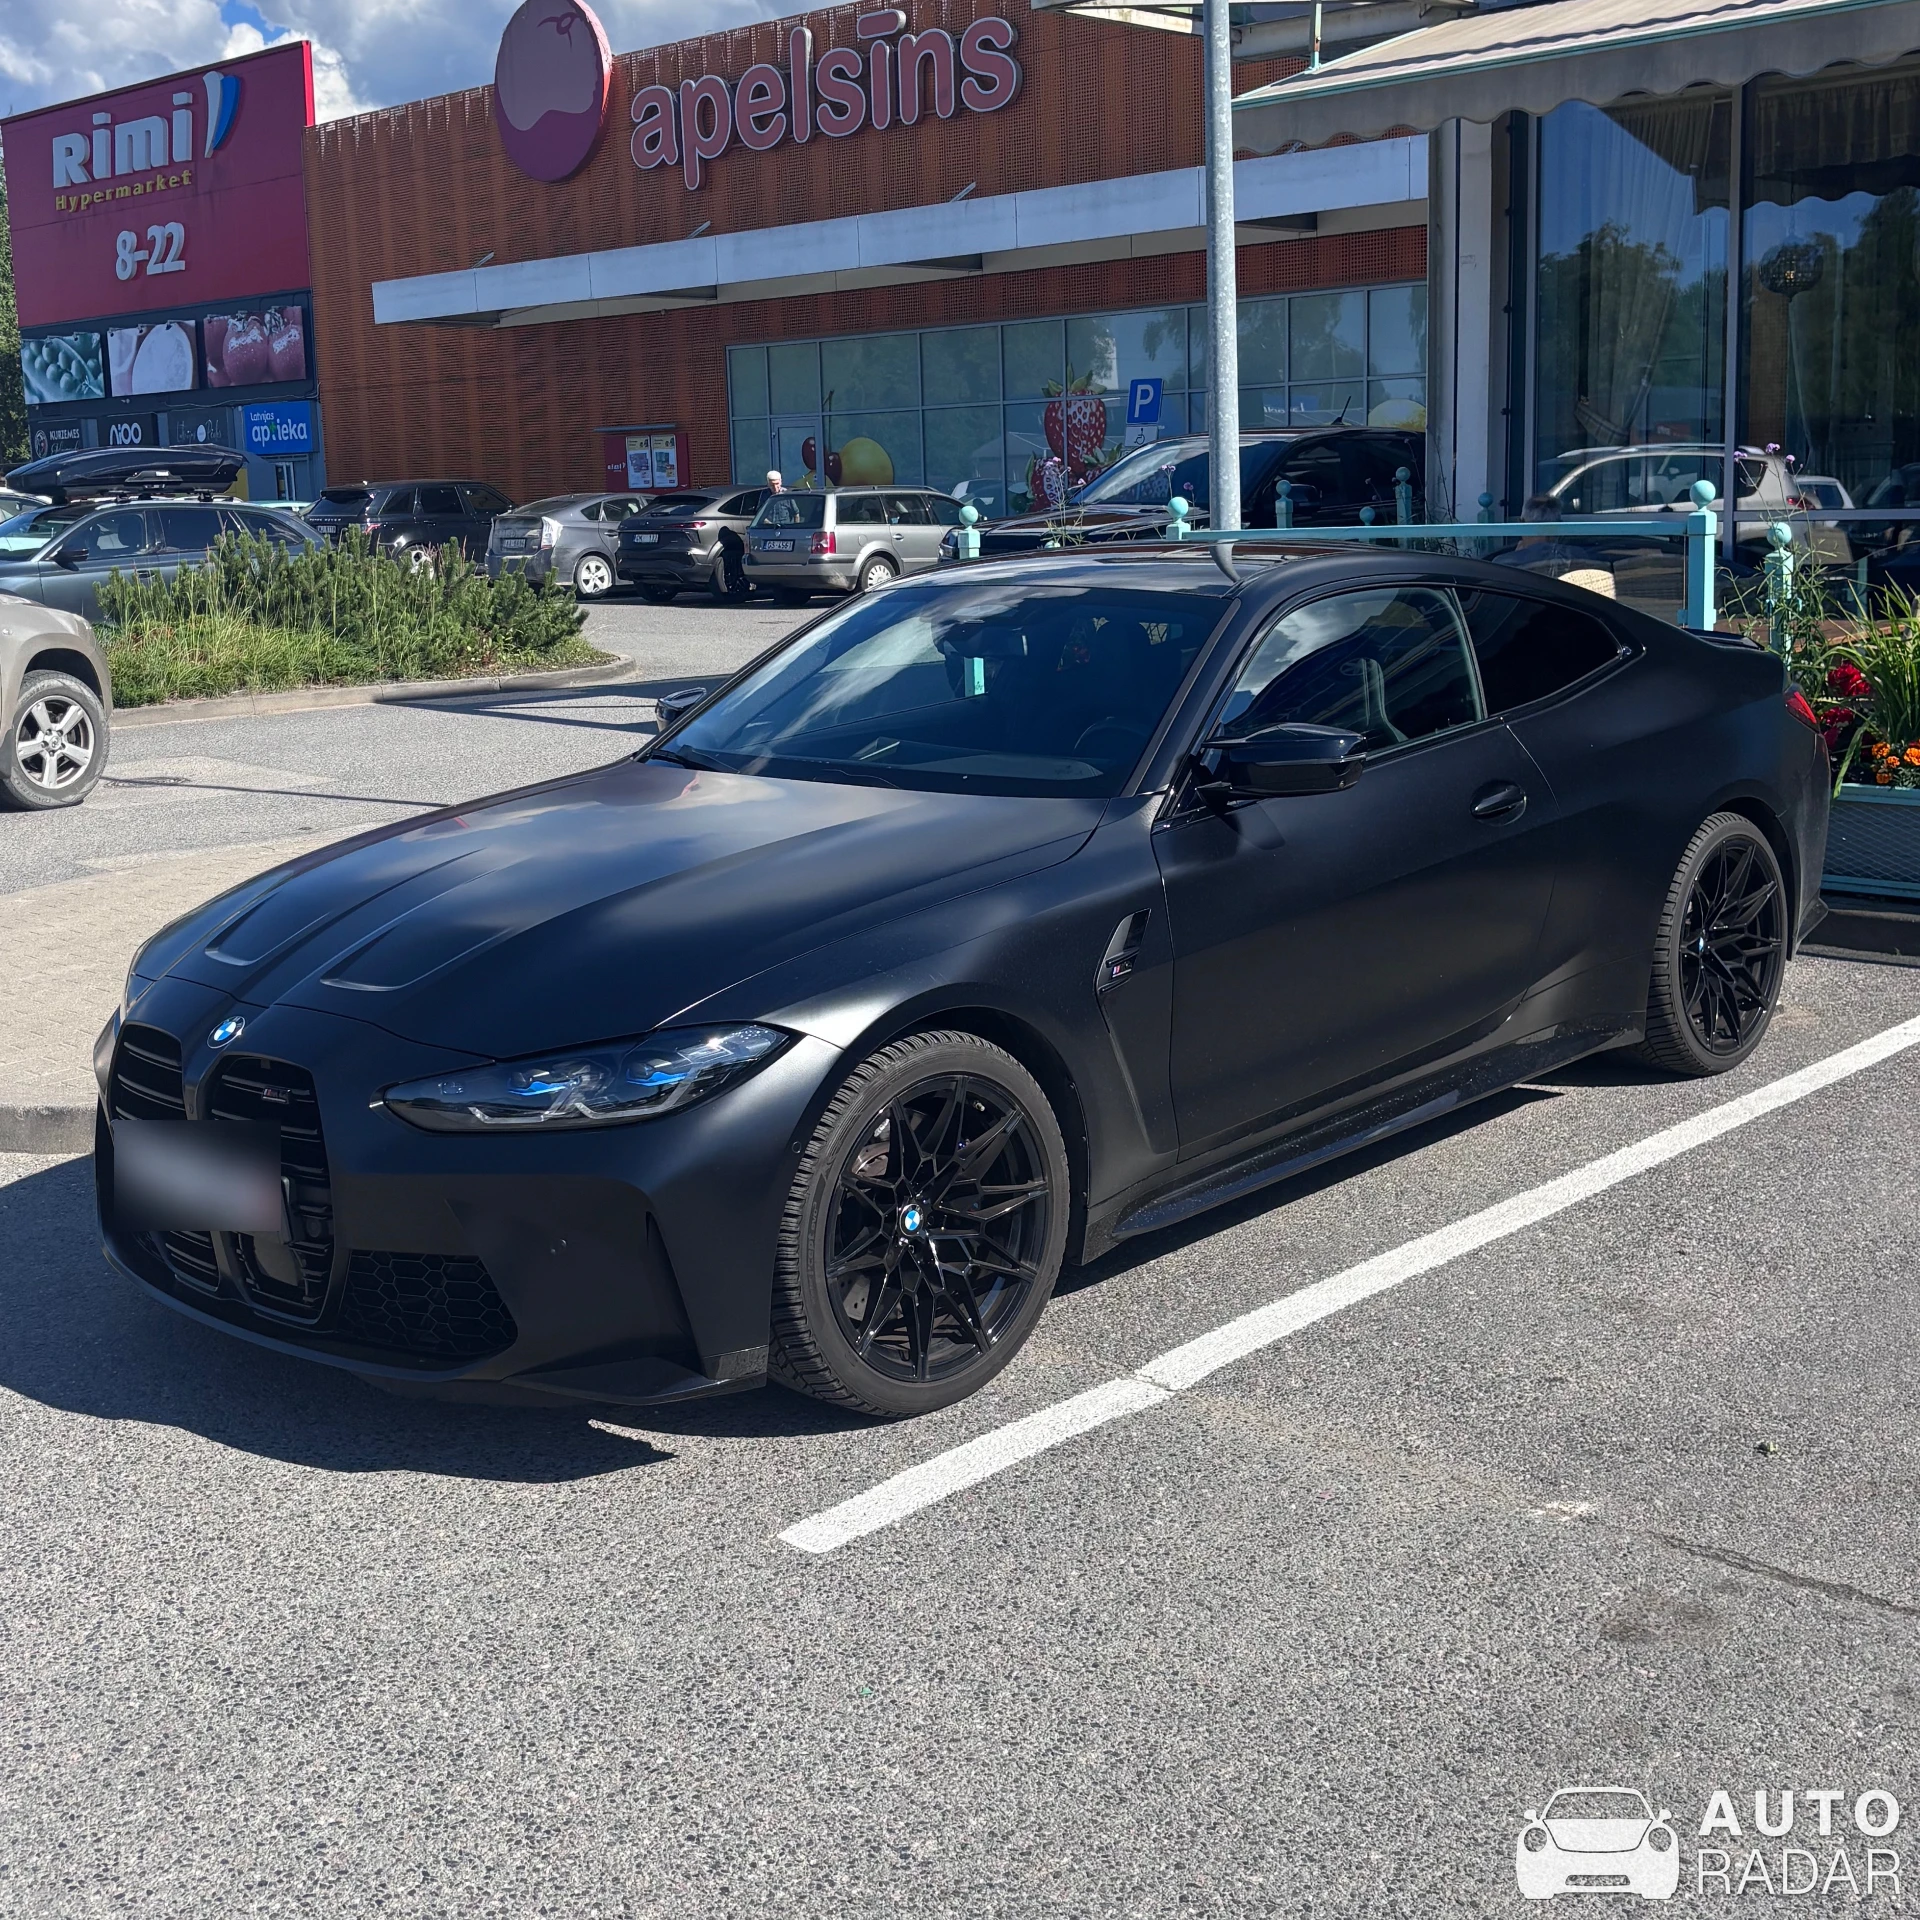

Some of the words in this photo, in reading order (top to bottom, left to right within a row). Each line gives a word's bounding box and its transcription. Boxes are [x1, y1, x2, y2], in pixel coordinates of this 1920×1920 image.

[630, 10, 1021, 190] apelsīns
[53, 91, 193, 189] Rimi
[55, 170, 192, 213] Hypermarket
[115, 221, 186, 281] 8-22
[1134, 384, 1154, 418] P
[252, 418, 308, 447] aptieka
